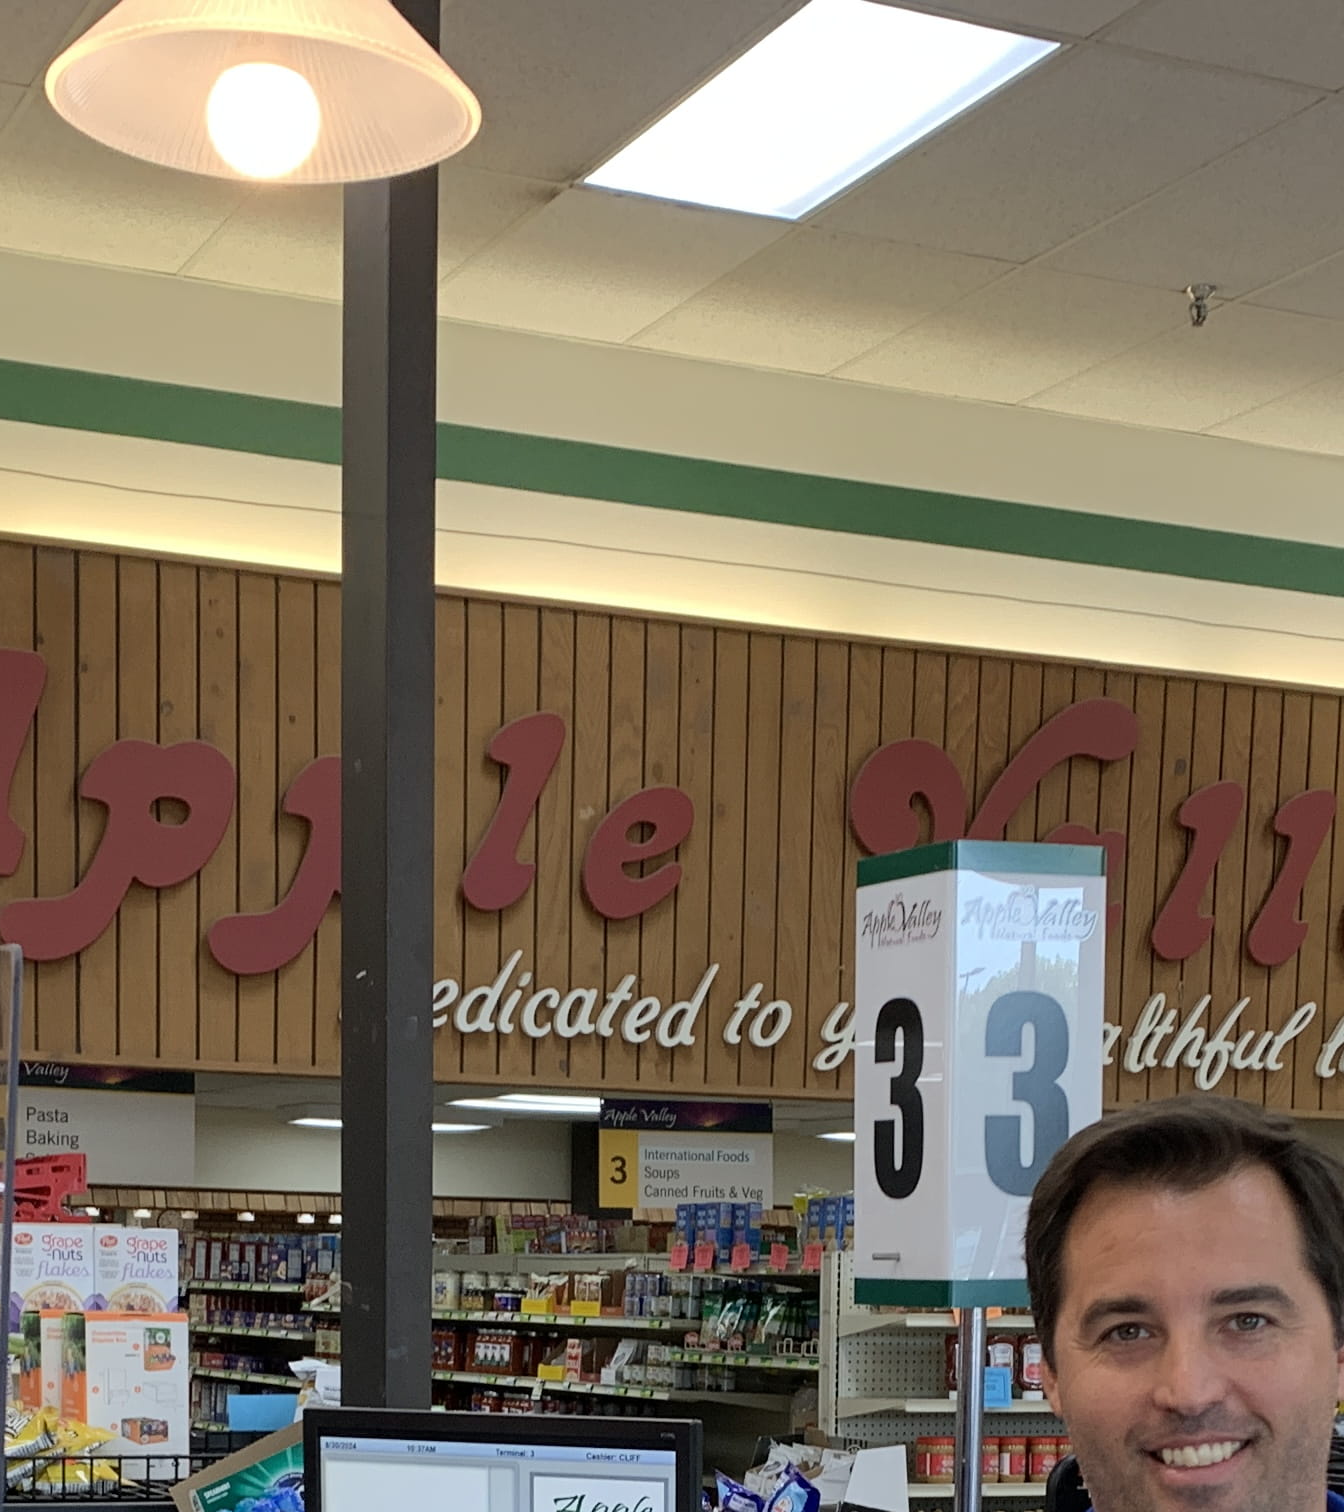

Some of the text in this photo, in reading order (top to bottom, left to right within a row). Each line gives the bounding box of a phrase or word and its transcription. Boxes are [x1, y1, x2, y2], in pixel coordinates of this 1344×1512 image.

[862, 900, 942, 948] Apple Valley
[432, 949, 720, 1048] edicated
[723, 980, 792, 1046] to
[24, 1062, 69, 1084] Valley
[874, 997, 924, 1200] 3
[984, 991, 1070, 1197] 3
[26, 1106, 69, 1124] Pasta
[604, 1107, 677, 1128] Apple Valley
[26, 1129, 80, 1150] Baking
[644, 1149, 749, 1163] International Foods
[610, 1155, 628, 1184] 3
[644, 1166, 680, 1180] Soups
[644, 1185, 763, 1201] Canned Fruits & Veg
[42, 1234, 83, 1254] grape
[127, 1236, 168, 1256] grape
[36, 1261, 90, 1279] flakes
[121, 1264, 174, 1281] flakes
